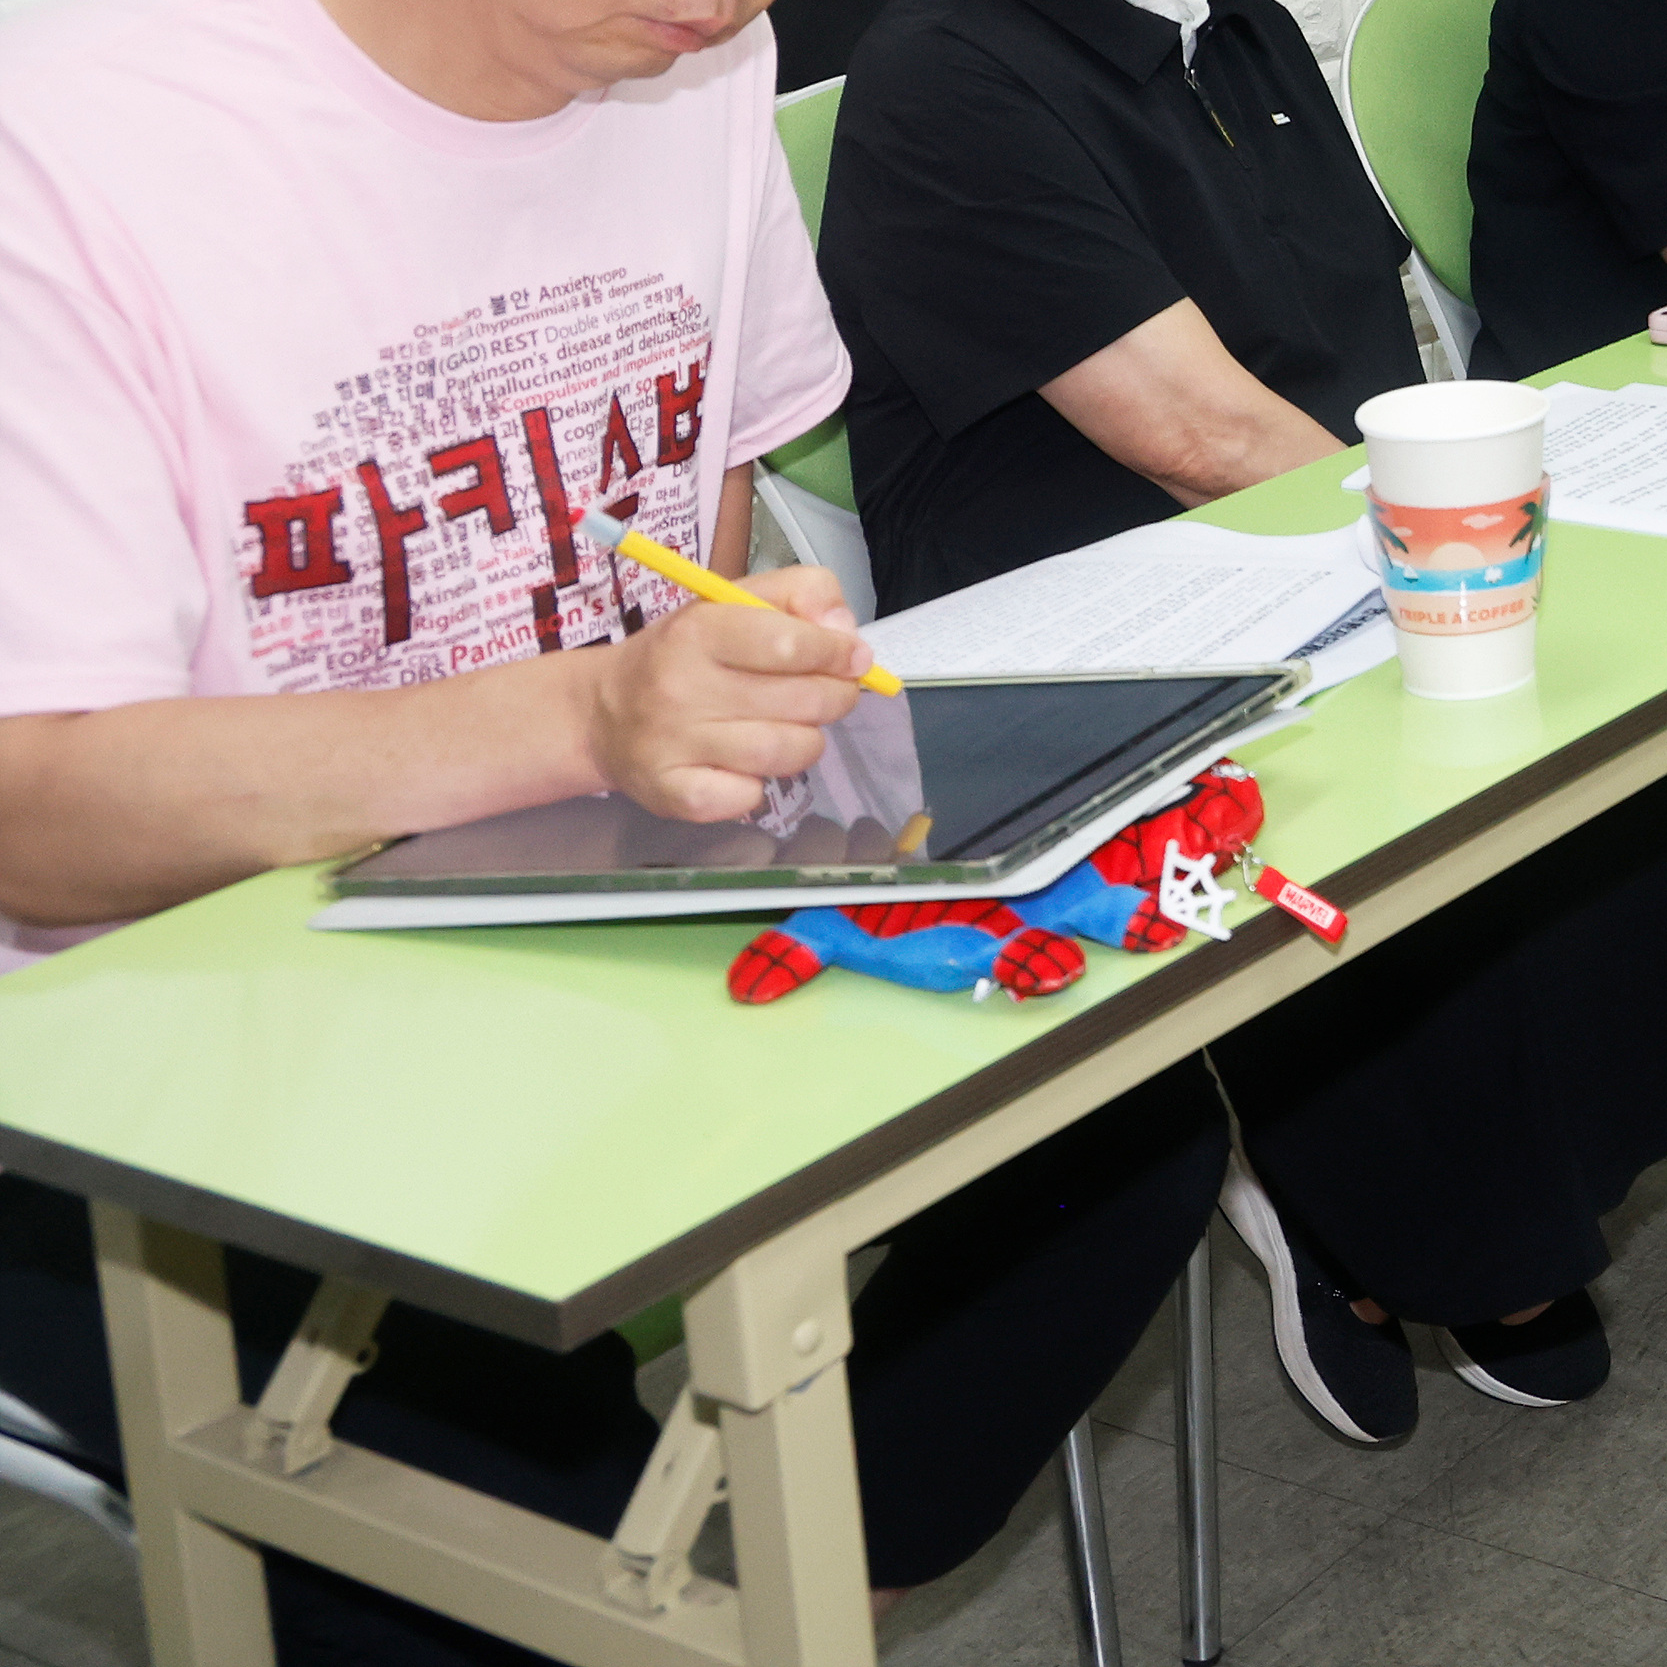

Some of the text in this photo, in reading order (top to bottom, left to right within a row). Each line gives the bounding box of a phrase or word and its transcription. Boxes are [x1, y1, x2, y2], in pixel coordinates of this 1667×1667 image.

[538, 275, 597, 302] Anxiety
[545, 314, 599, 344] Double
[602, 301, 641, 325] vision
[555, 333, 612, 361] disease
[480, 354, 610, 403] Hallucinations
[1399, 598, 1525, 625] TRIPLE A COFFEE
